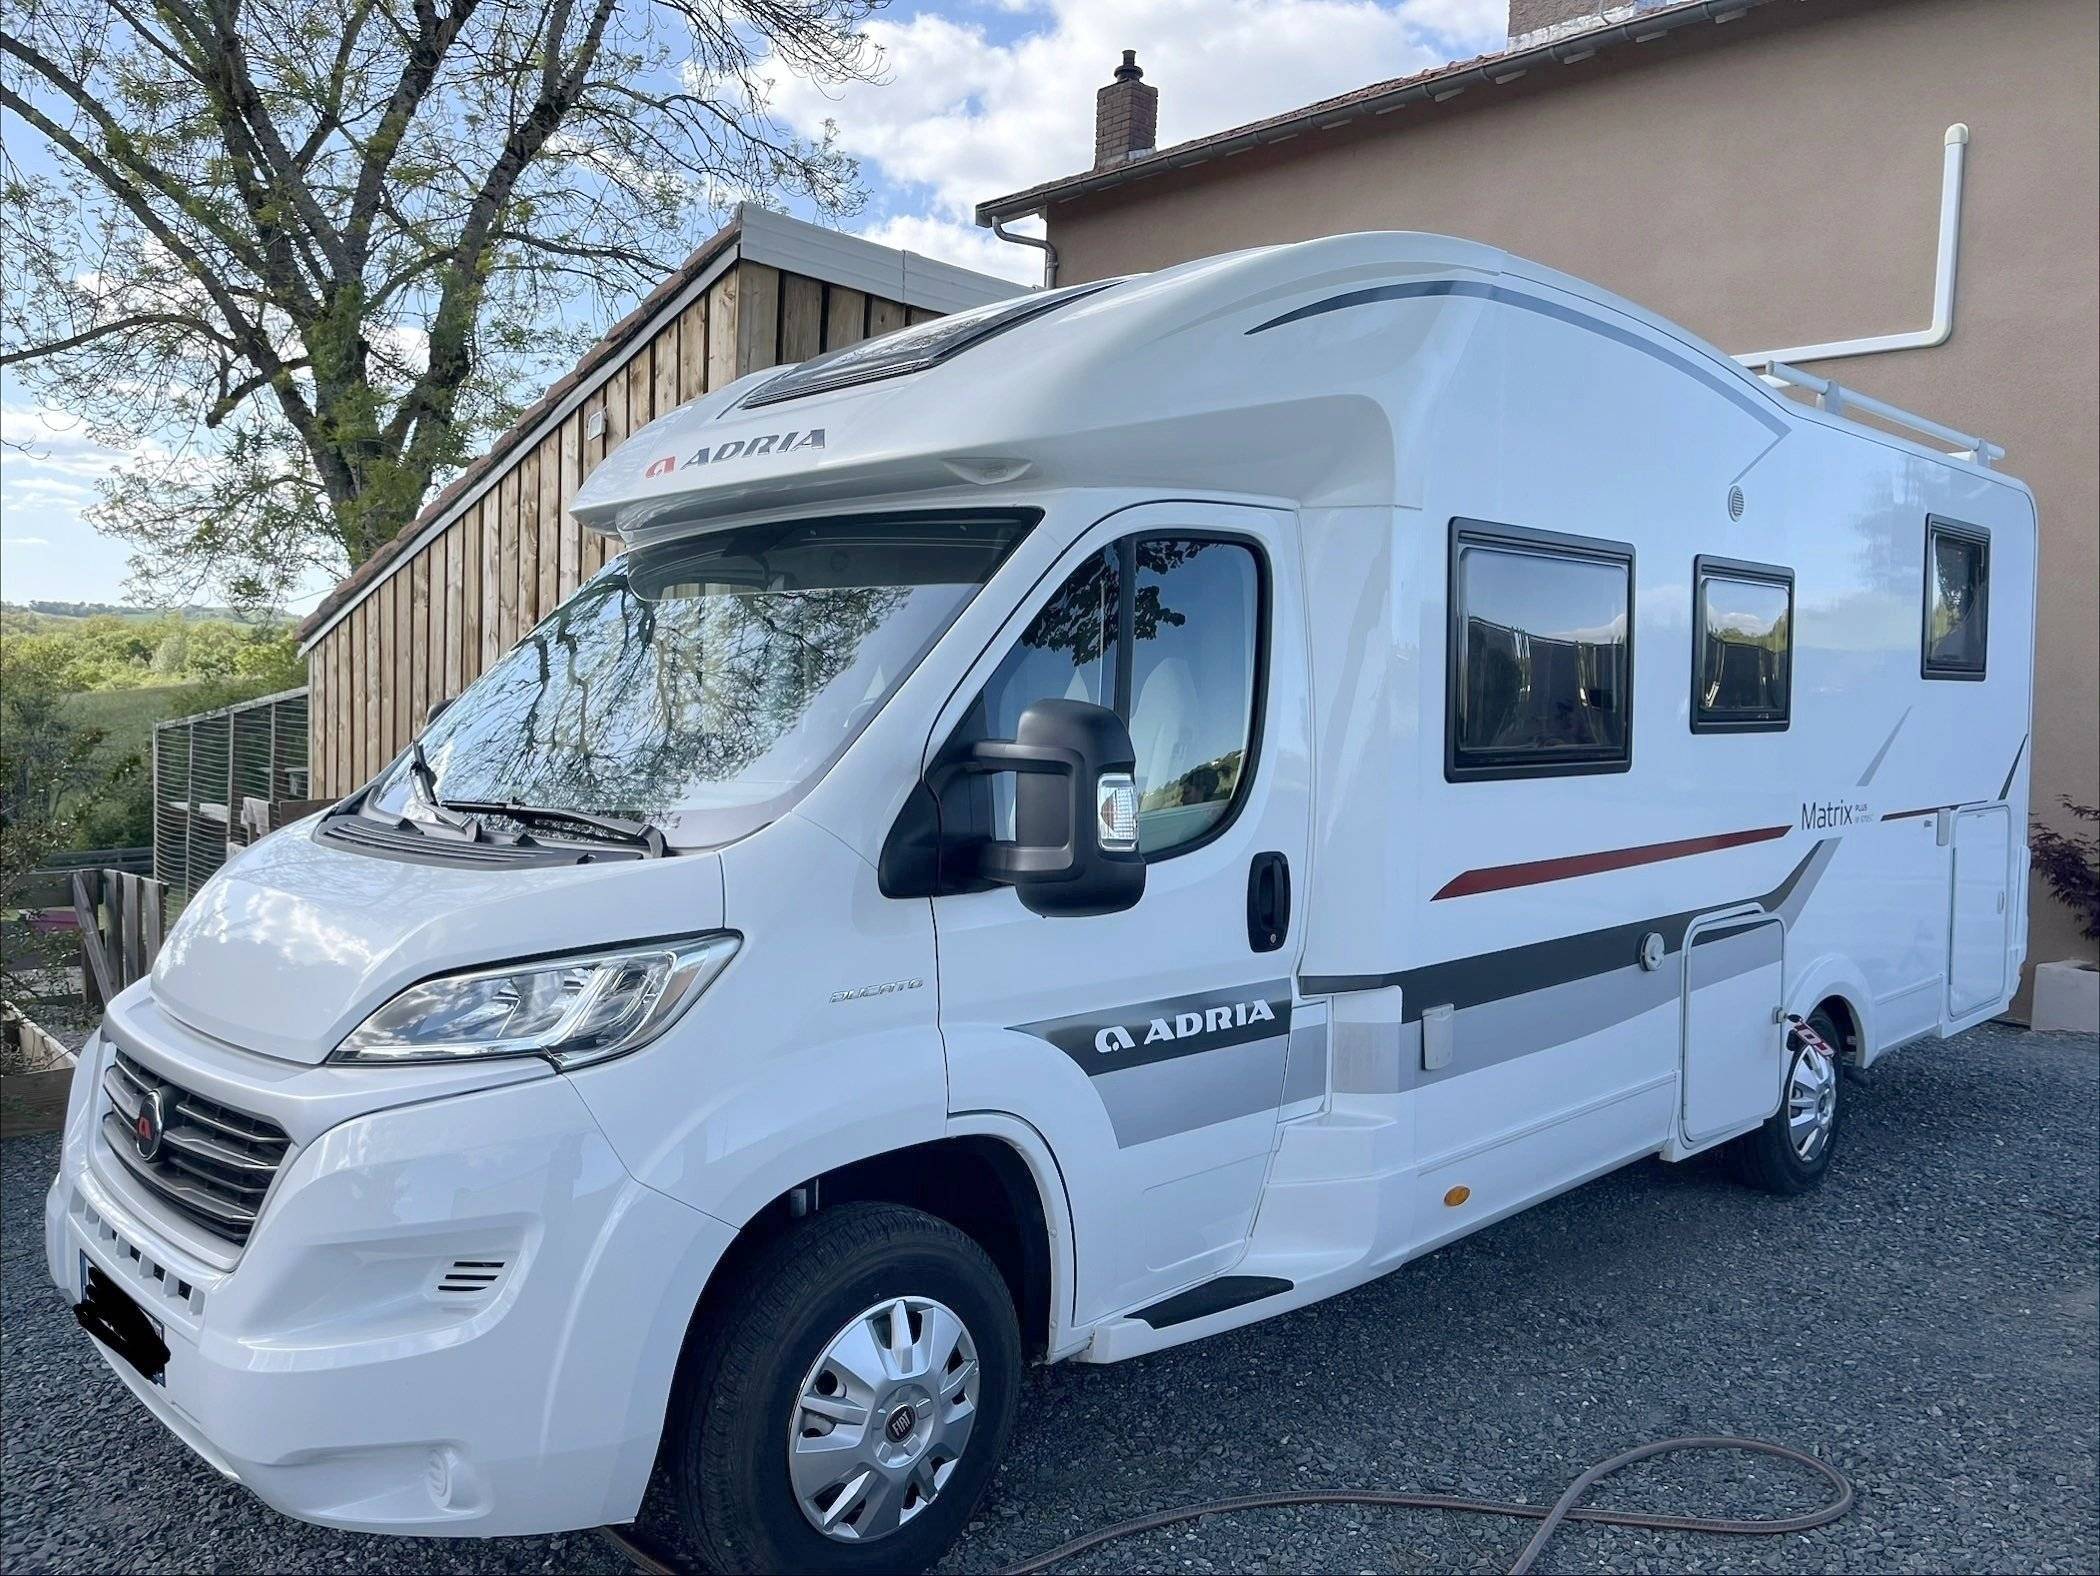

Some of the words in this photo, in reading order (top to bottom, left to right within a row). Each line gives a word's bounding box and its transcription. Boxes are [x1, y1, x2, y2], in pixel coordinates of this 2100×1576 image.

[680, 428, 826, 471] ADRIA
[1801, 799, 1853, 830] Matrix
[1143, 999, 1276, 1045] ADRIA
[891, 1411, 911, 1436] FIAT
